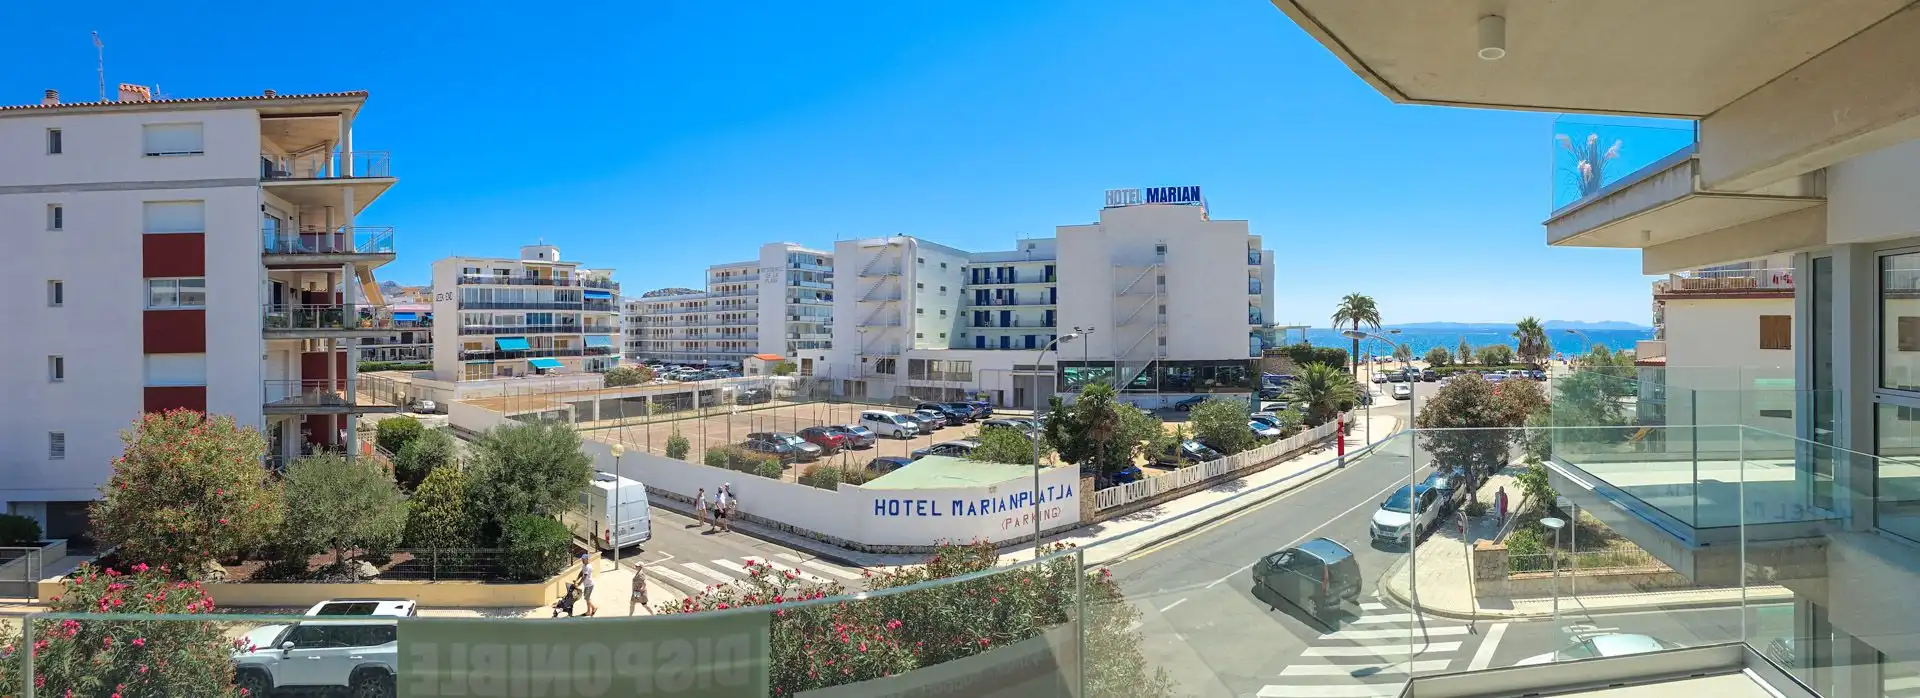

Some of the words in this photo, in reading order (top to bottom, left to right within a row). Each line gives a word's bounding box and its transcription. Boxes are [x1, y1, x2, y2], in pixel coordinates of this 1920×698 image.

[1105, 189, 1142, 206] HOTEL
[1147, 186, 1200, 203] MARIAN
[874, 499, 942, 517] HOTEL
[951, 484, 1074, 516] MARIANPLATJA
